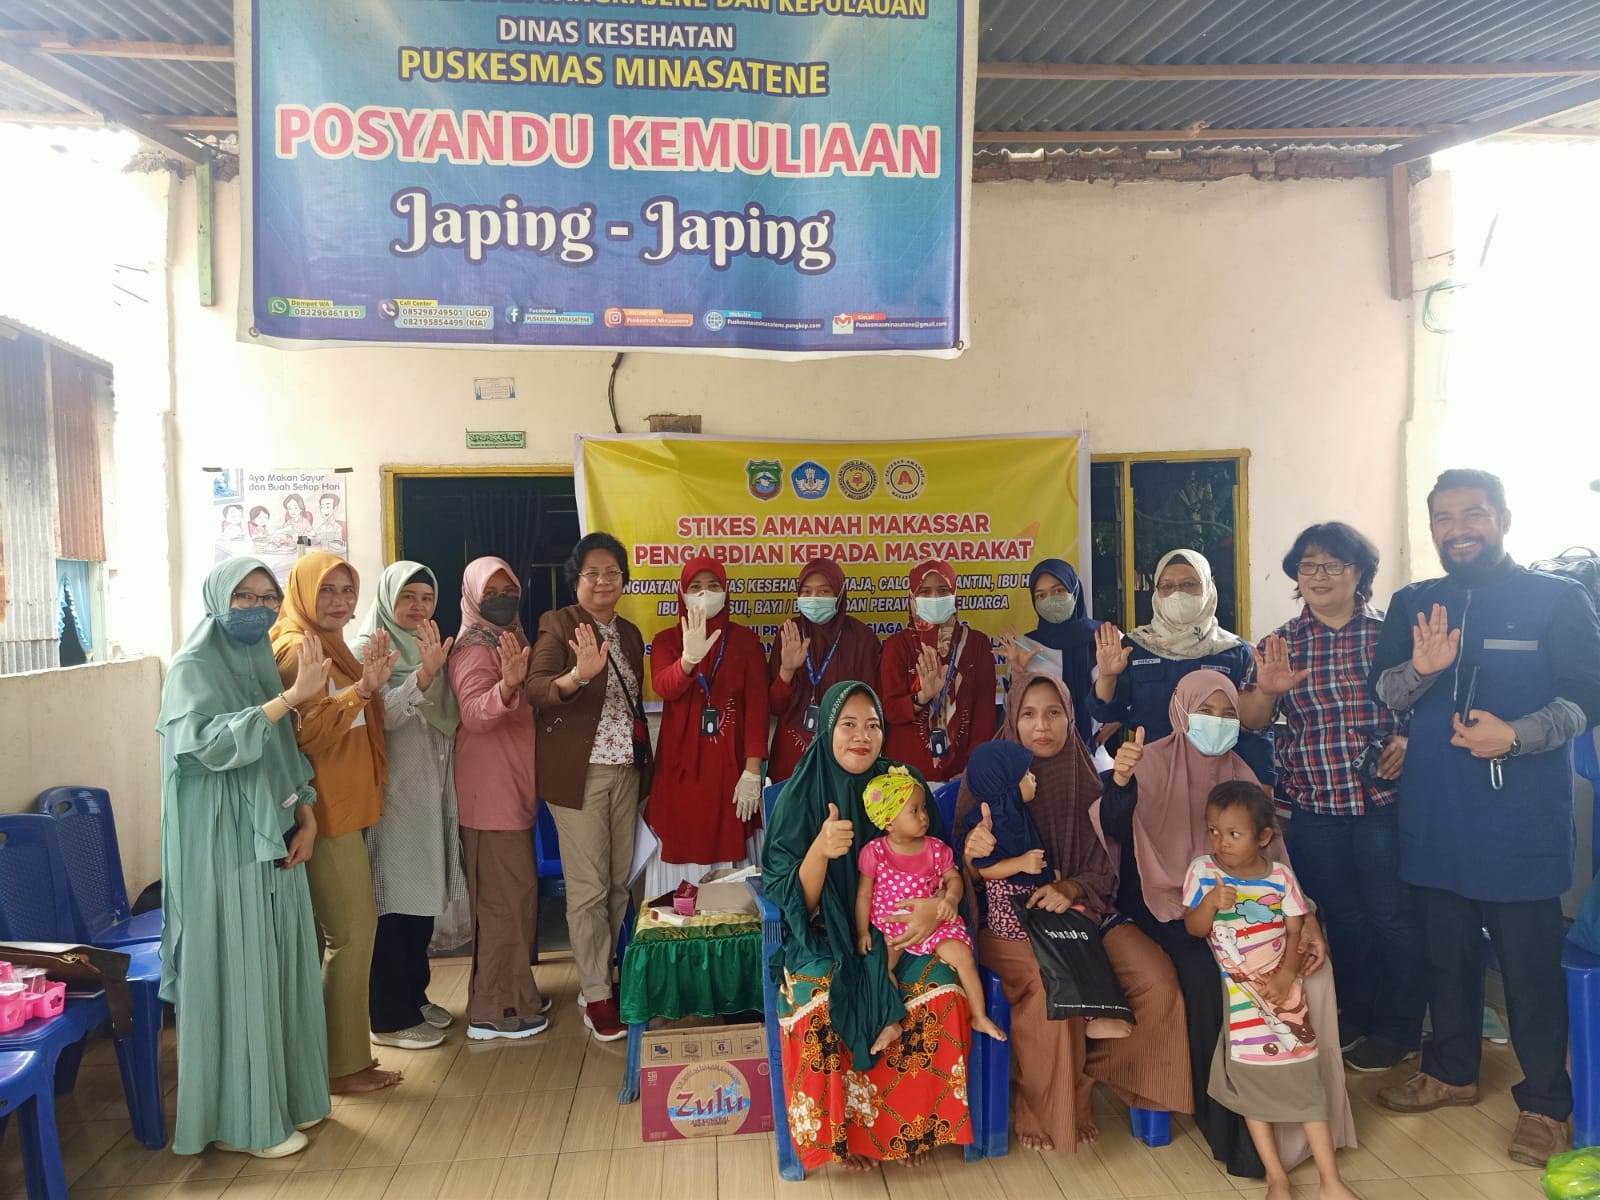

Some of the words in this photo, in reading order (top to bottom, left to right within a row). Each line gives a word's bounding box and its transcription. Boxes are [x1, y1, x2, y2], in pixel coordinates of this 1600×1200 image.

[499, 18, 579, 44] DINAS
[588, 22, 734, 49] KESEHATAN
[401, 50, 604, 85] PUSKESMAS
[615, 57, 828, 95] MINASATENE
[275, 102, 594, 169] POSYANDU
[608, 115, 942, 179] KEMULIAAN
[393, 190, 595, 264] Japing
[610, 226, 629, 236] -
[643, 200, 831, 270] Japing
[466, 309, 491, 318] (UGD)
[466, 319, 487, 328] (KIA)
[248, 473, 265, 483] Ayo
[267, 473, 298, 482] Makan
[300, 473, 325, 483] Sayur
[248, 483, 266, 491] dan
[267, 483, 291, 491] Buah
[292, 482, 320, 492] Setiap
[321, 482, 341, 491] Hari
[678, 516, 757, 537] STIKES
[762, 515, 862, 536] AMANAH
[868, 514, 991, 535] MAKASSAR
[634, 544, 784, 566] PENGABDIAN
[789, 543, 879, 564] KEPADA
[885, 540, 1033, 562] MASYARAKAT
[997, 574, 1018, 588] IBU
[658, 601, 679, 615] IBU
[754, 600, 783, 614] BAYI
[956, 595, 1009, 609] ELUARGA
[676, 1086, 744, 1117] Zulu
